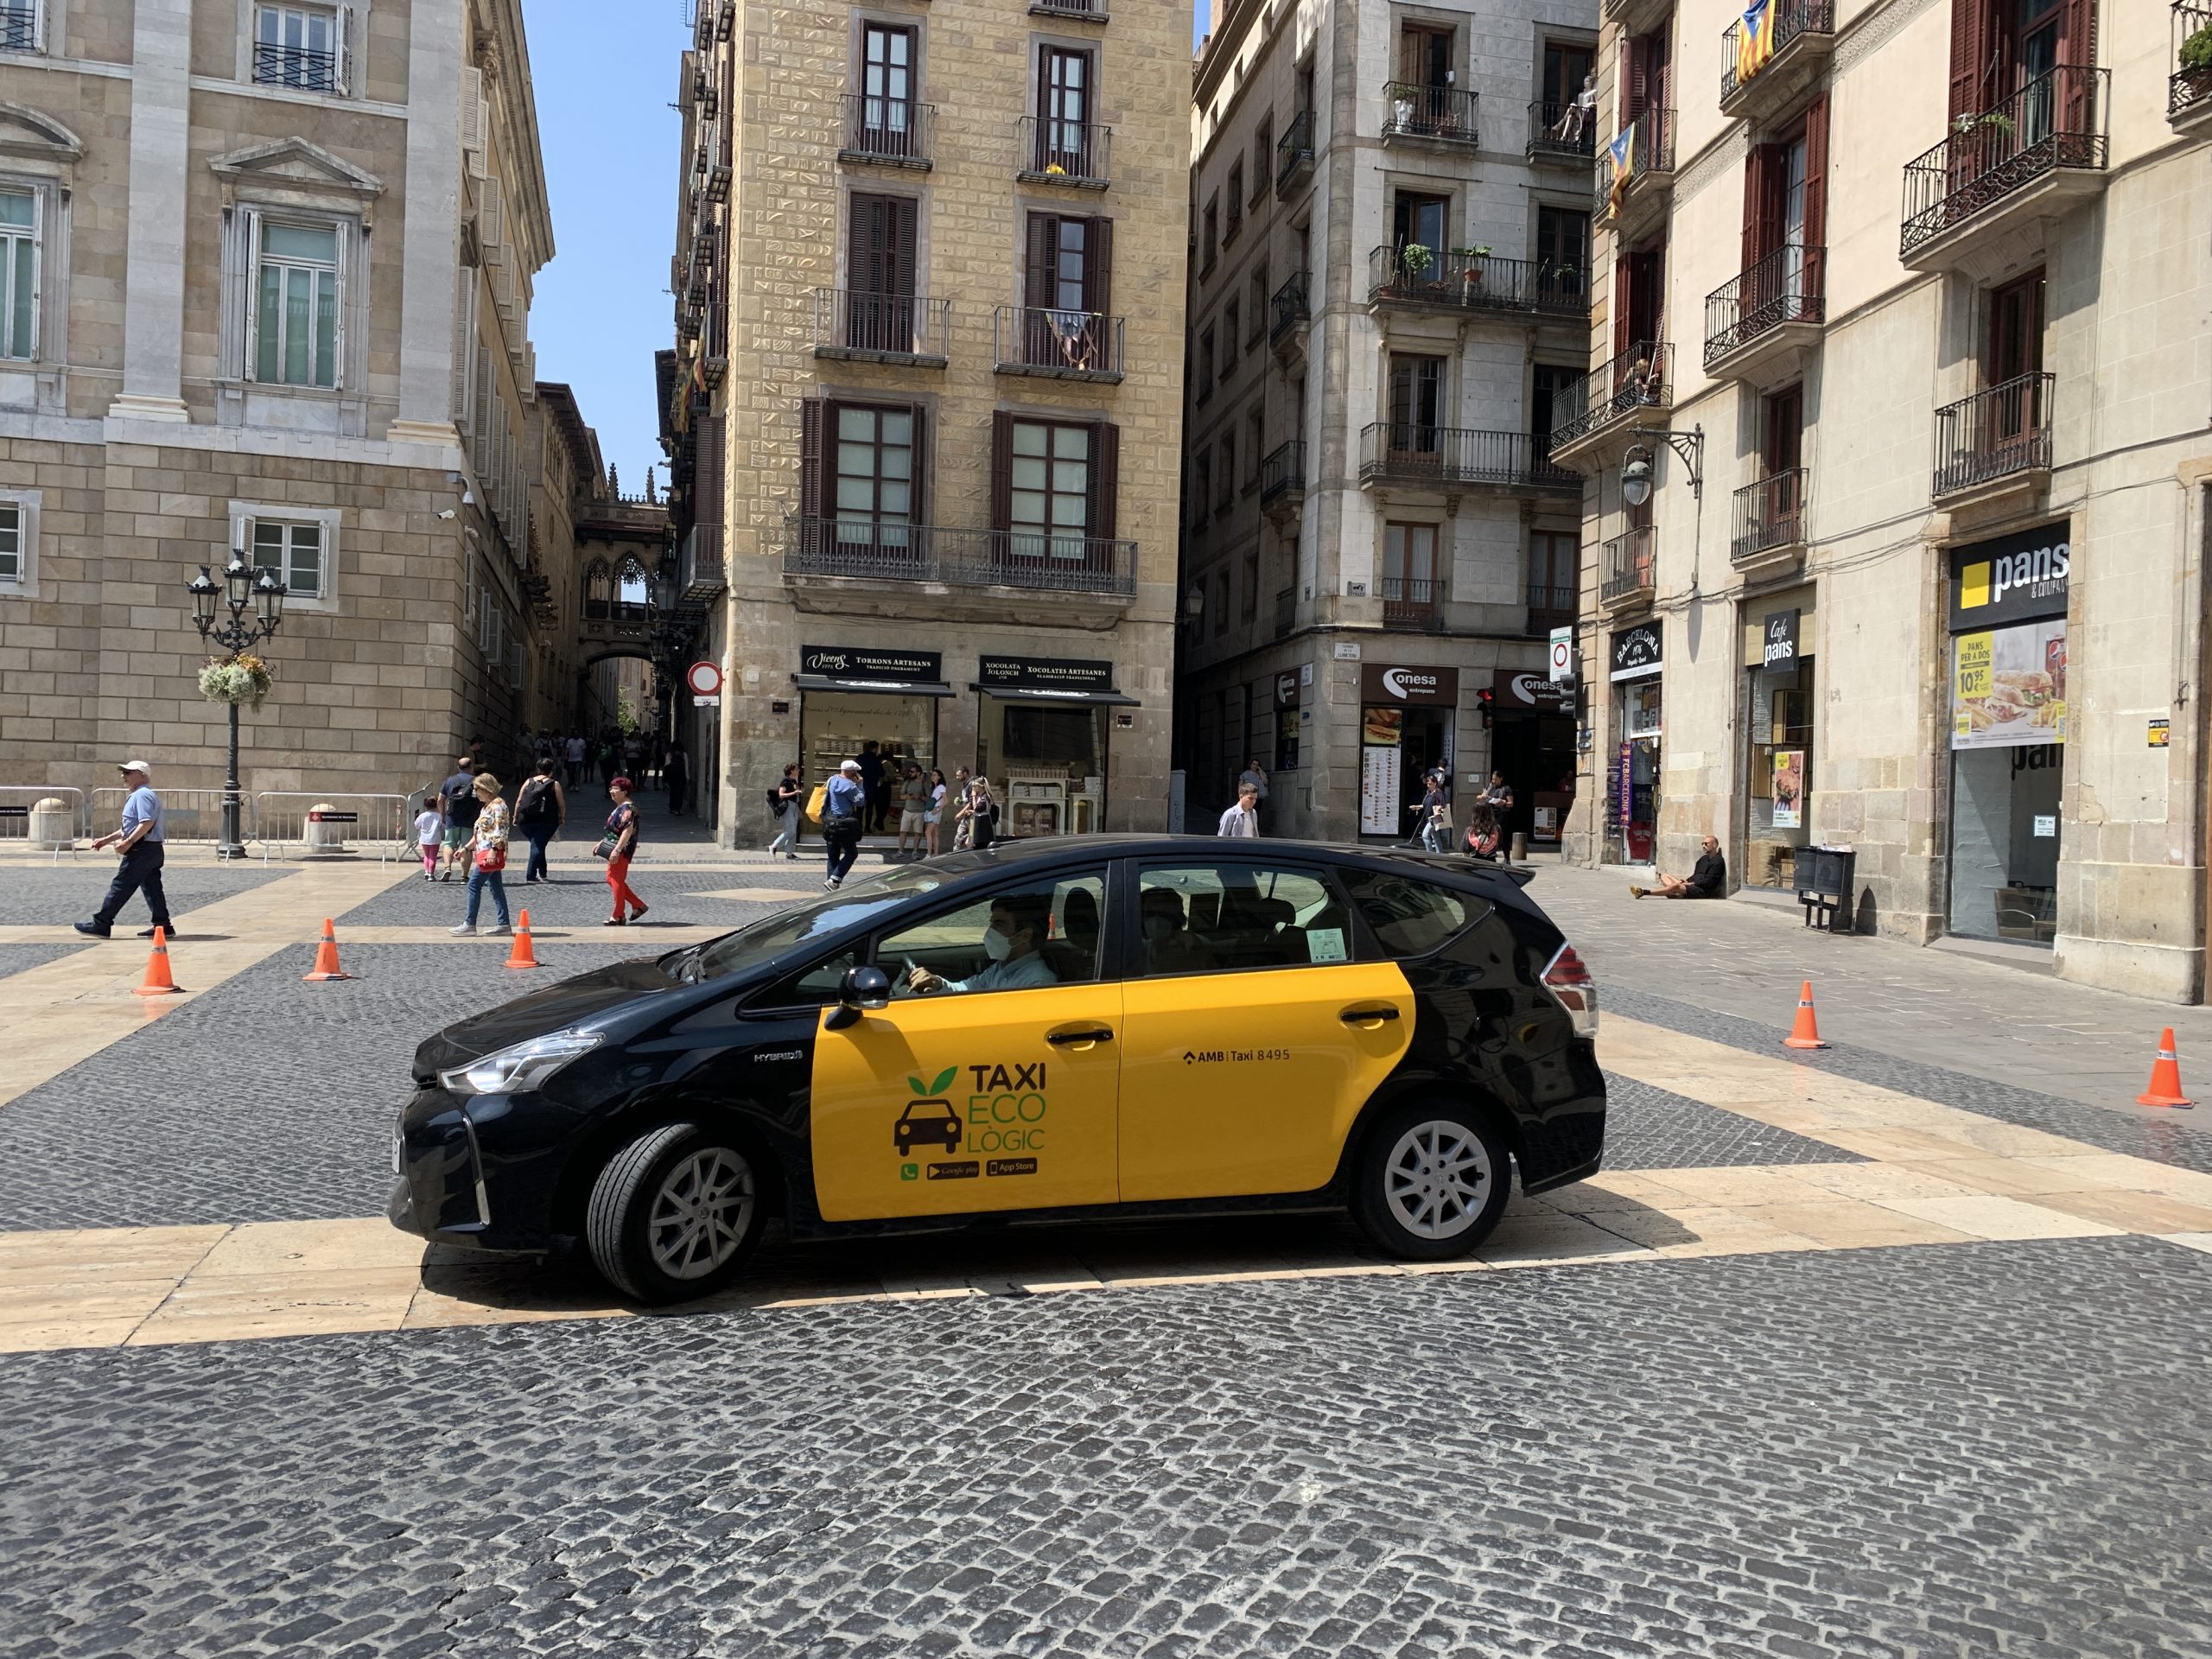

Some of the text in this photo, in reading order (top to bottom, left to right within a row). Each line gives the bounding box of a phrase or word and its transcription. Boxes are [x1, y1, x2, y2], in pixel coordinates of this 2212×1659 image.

[1994, 543, 2069, 603] pans
[2031, 583, 2037, 598] &
[1617, 629, 1658, 664] BARCELONA
[1764, 640, 1793, 667] pans
[1967, 641, 1984, 652] PANS
[807, 653, 849, 670] Vicens
[1961, 650, 1990, 663] PER A DOS
[754, 1052, 795, 1062] HYBRID
[1198, 1049, 1290, 1062] AMB Taxi 8495
[969, 1063, 1046, 1092] TAXI
[968, 1093, 1046, 1124] ECO
[968, 1125, 1045, 1153] LÒGIC
[942, 1166, 963, 1175] Google
[1015, 1162, 1034, 1171] Store
